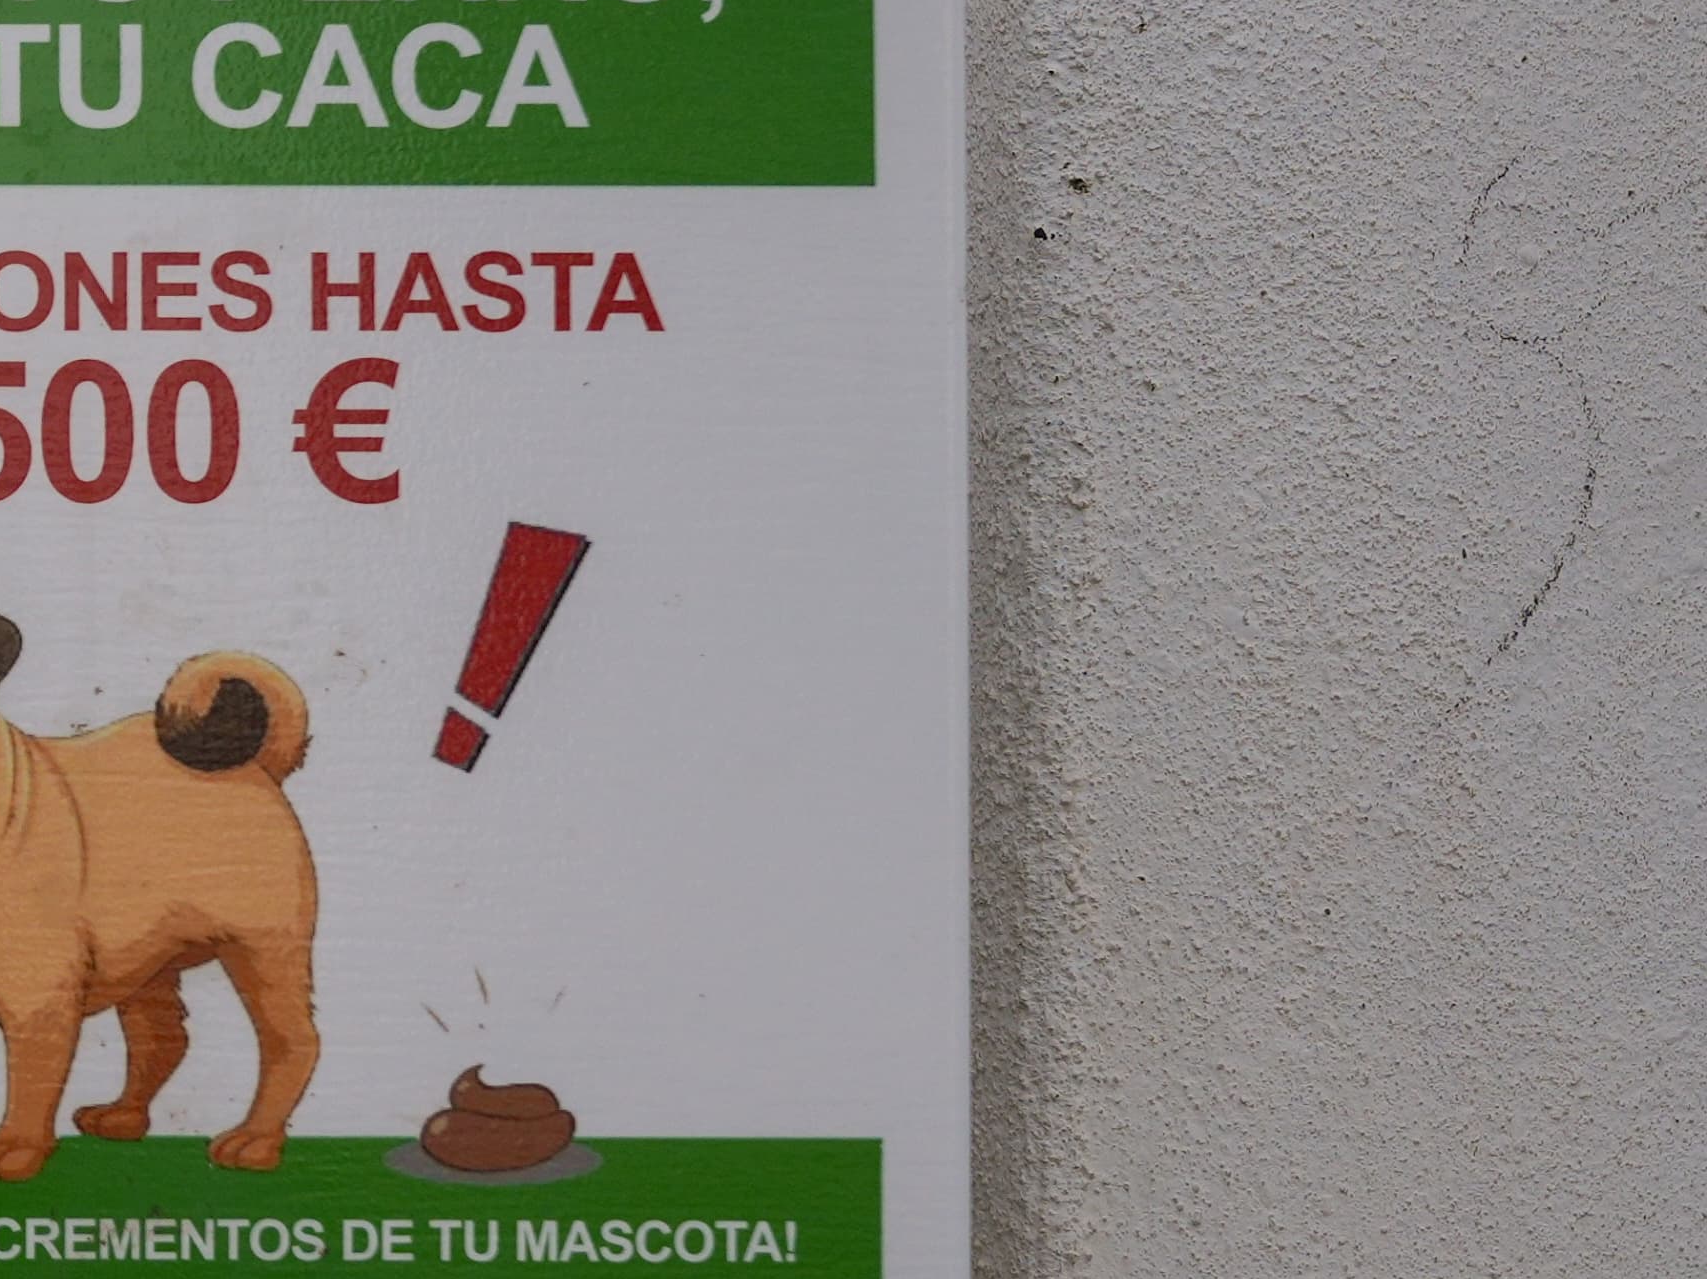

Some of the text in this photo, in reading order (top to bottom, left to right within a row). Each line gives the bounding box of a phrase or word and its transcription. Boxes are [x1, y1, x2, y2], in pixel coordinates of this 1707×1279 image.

[191, 21, 590, 130] CACA
[311, 250, 666, 334] HASTA
[292, 357, 402, 506] €
[343, 1219, 415, 1262] DE
[429, 1219, 500, 1263] TU
[517, 1220, 797, 1264] MASCOTA!
